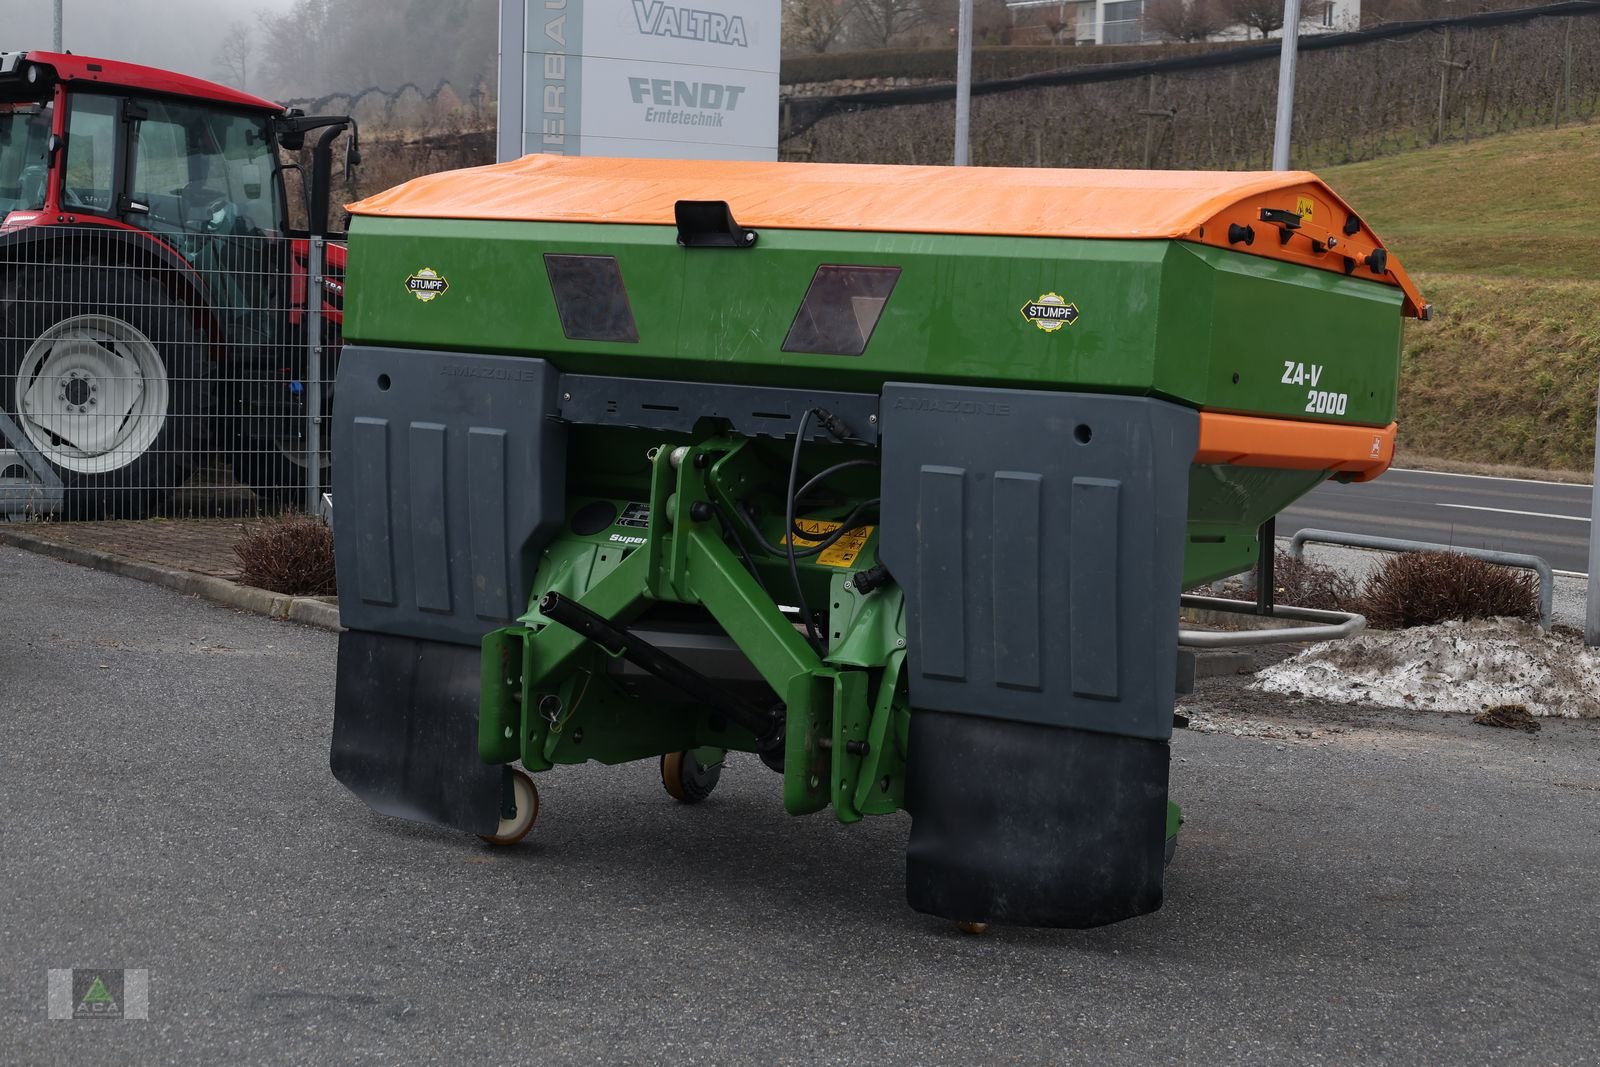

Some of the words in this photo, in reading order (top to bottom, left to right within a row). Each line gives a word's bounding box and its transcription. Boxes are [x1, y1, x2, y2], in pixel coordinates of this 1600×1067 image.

[632, 0, 748, 48] VALTRA
[628, 77, 746, 111] FENDT
[645, 107, 724, 127] Erntetechnik
[410, 279, 442, 290] STUMPF
[1029, 305, 1071, 318] STUMPF
[1281, 360, 1323, 387] ZA-V
[1305, 390, 1347, 415] 2000
[609, 534, 648, 544] Super
